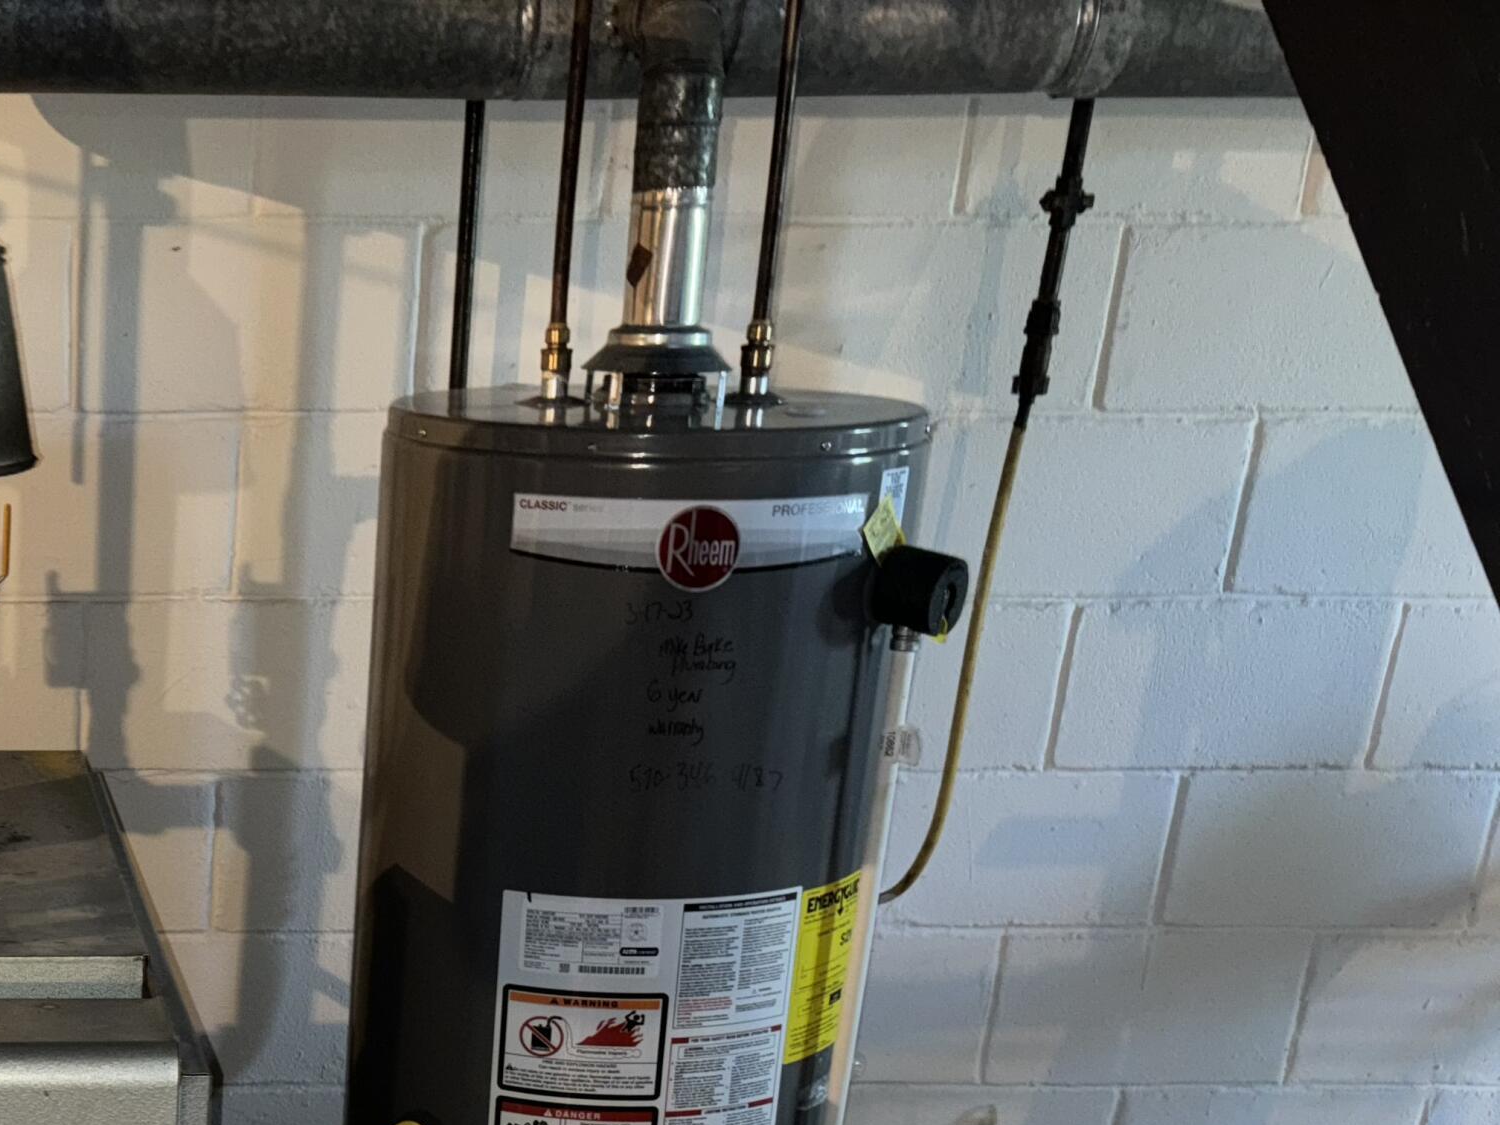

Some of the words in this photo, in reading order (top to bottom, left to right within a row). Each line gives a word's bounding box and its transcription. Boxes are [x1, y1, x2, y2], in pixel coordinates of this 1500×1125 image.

[519, 499, 567, 511] CLASSIC
[771, 498, 865, 517] PROFESSIONAL
[666, 507, 736, 577] Rheem
[564, 999, 619, 1008] WARNING
[555, 1110, 601, 1120] DANGER
